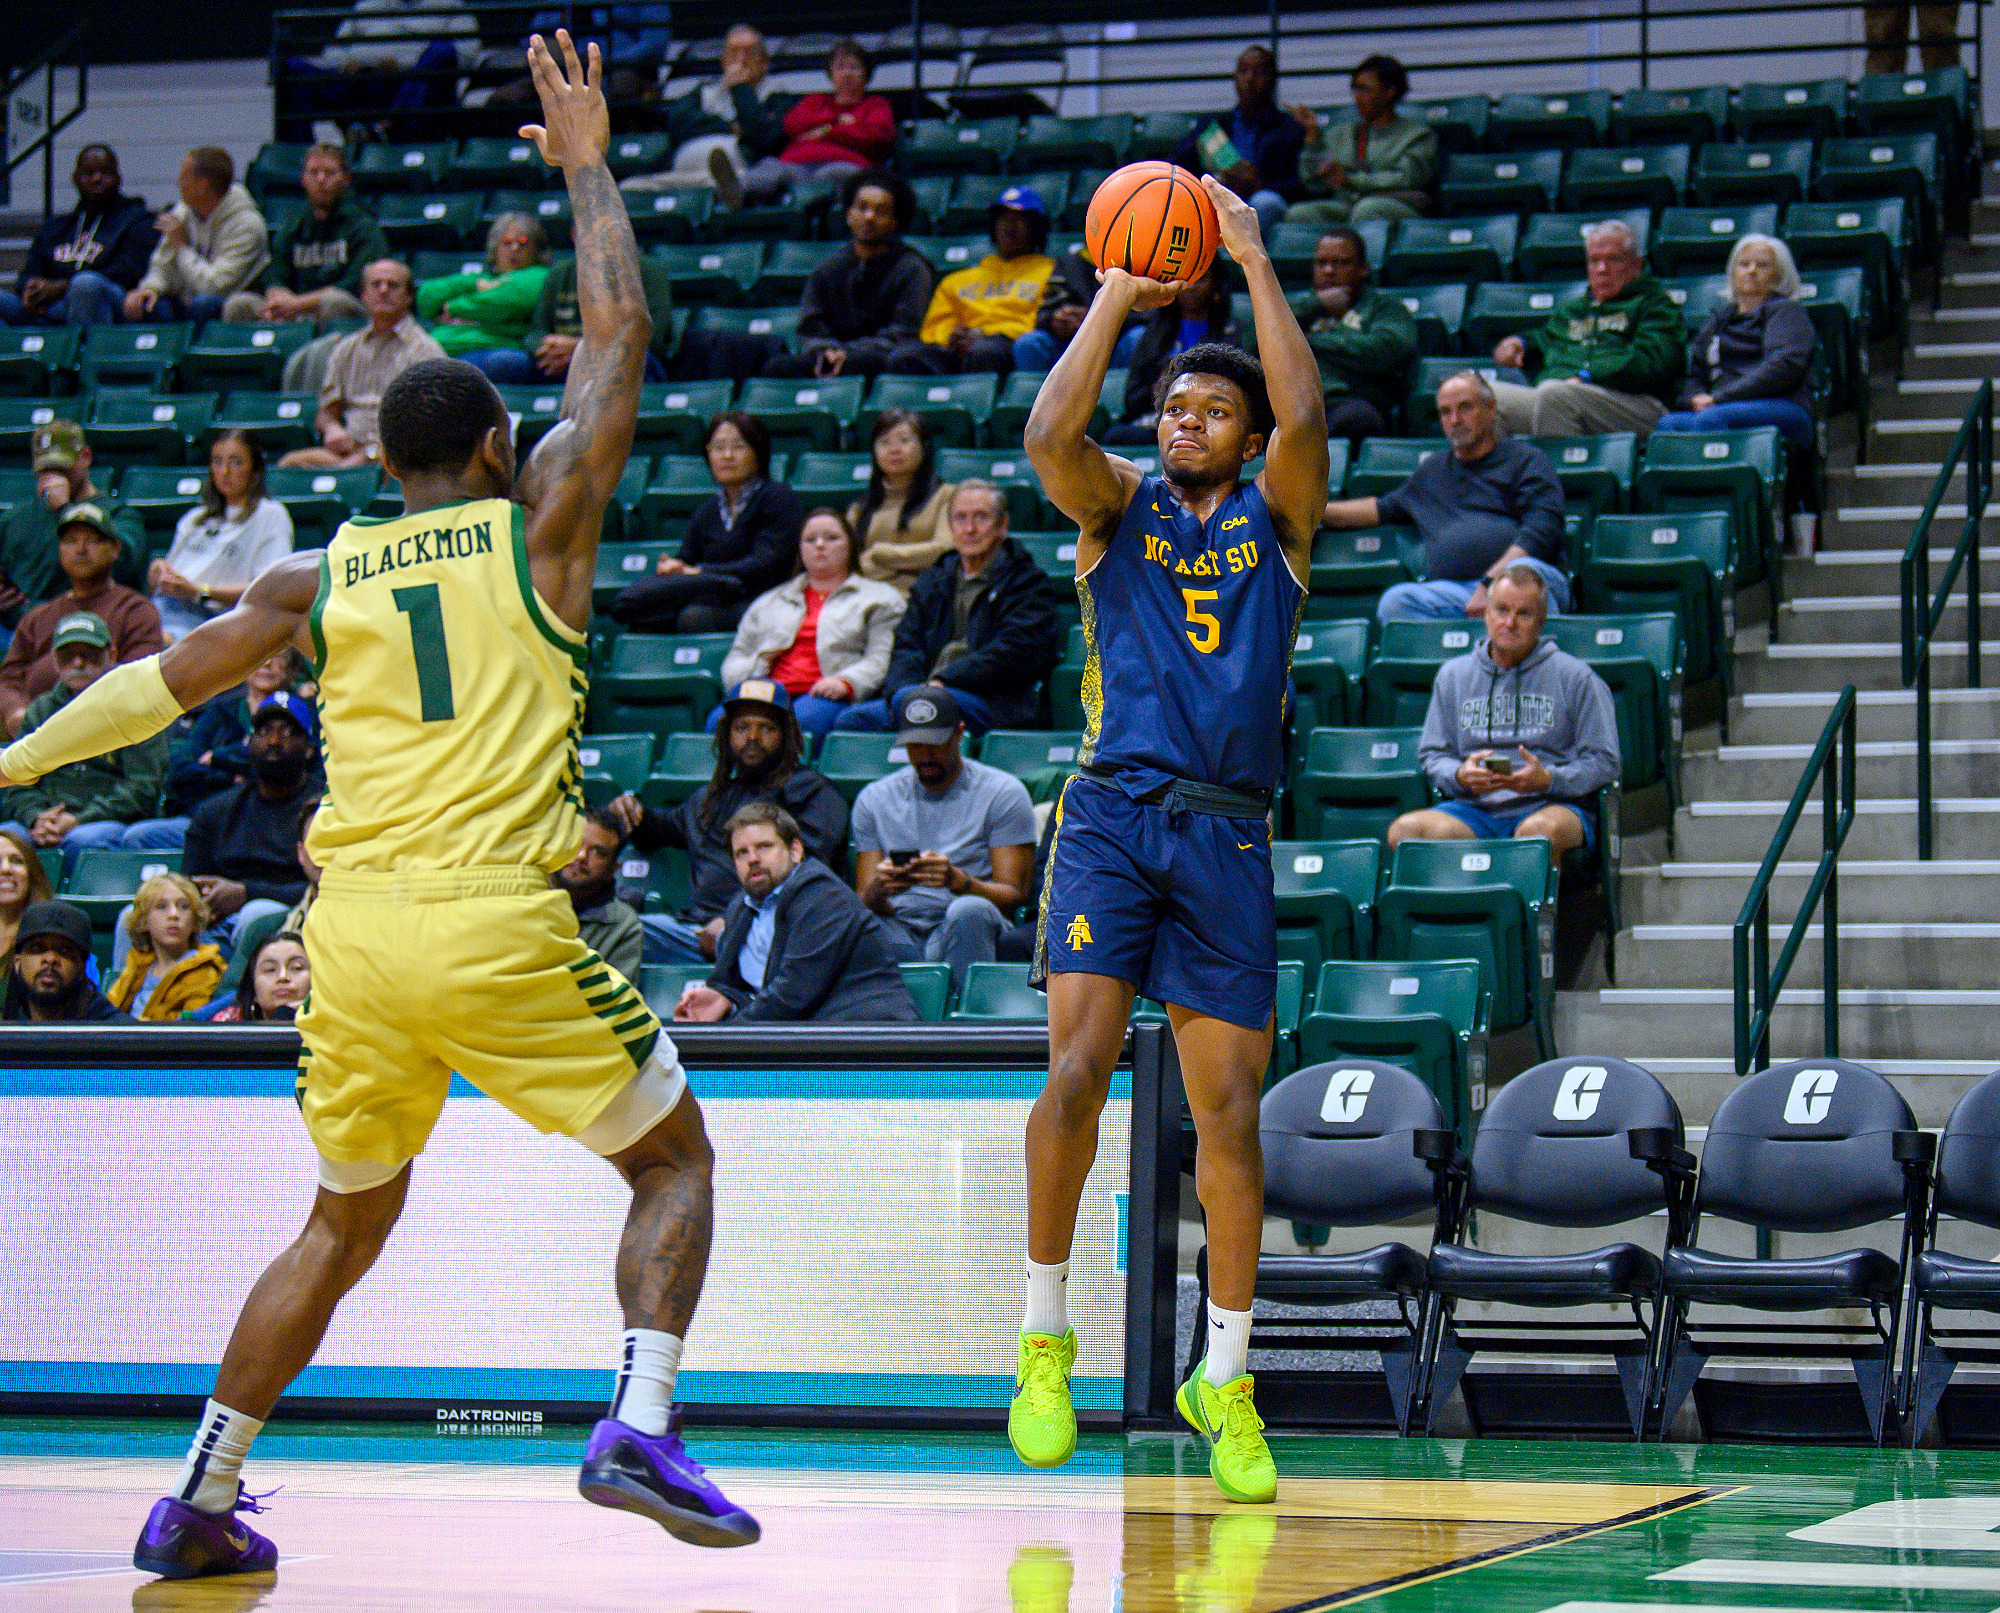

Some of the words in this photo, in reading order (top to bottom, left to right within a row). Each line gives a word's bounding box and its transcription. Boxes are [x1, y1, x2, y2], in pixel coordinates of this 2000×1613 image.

[1221, 515, 1249, 531] CAA
[345, 520, 493, 588] BLACKMON
[1144, 534, 1172, 567] NC
[1174, 550, 1221, 576] A&T
[1225, 540, 1259, 573] SU
[1181, 588, 1221, 654] 5
[391, 583, 455, 723] 1
[1460, 692, 1555, 731] CHARLTTE
[1300, 859, 1317, 871] 14
[1468, 857, 1485, 870] 15
[436, 1408, 543, 1423] DAKTRONICS
